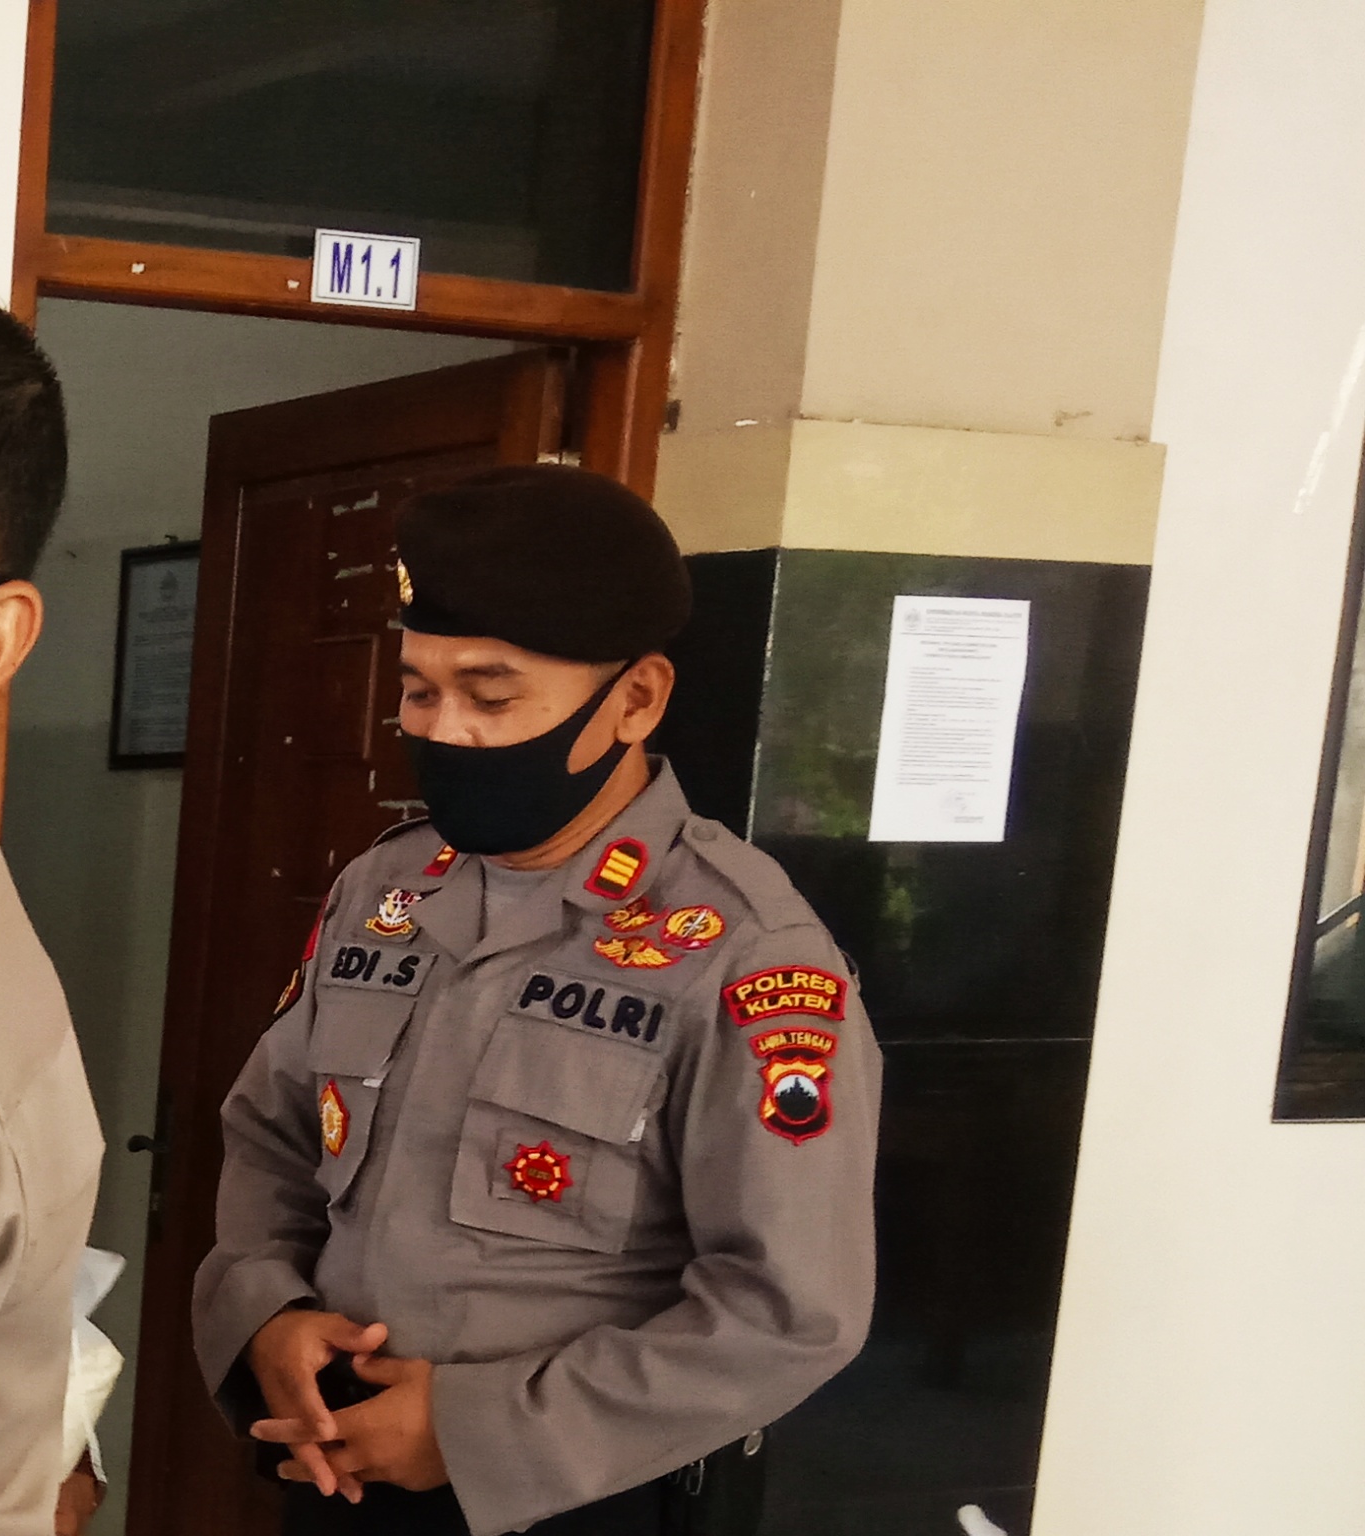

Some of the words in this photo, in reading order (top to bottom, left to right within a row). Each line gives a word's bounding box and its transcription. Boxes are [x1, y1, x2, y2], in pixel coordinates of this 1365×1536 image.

[330, 242, 401, 298] M1.1
[736, 971, 838, 1001] POLRES
[519, 973, 664, 1043] POLRI
[746, 993, 832, 1016] KLATEN
[790, 1031, 833, 1051] TENGAH
